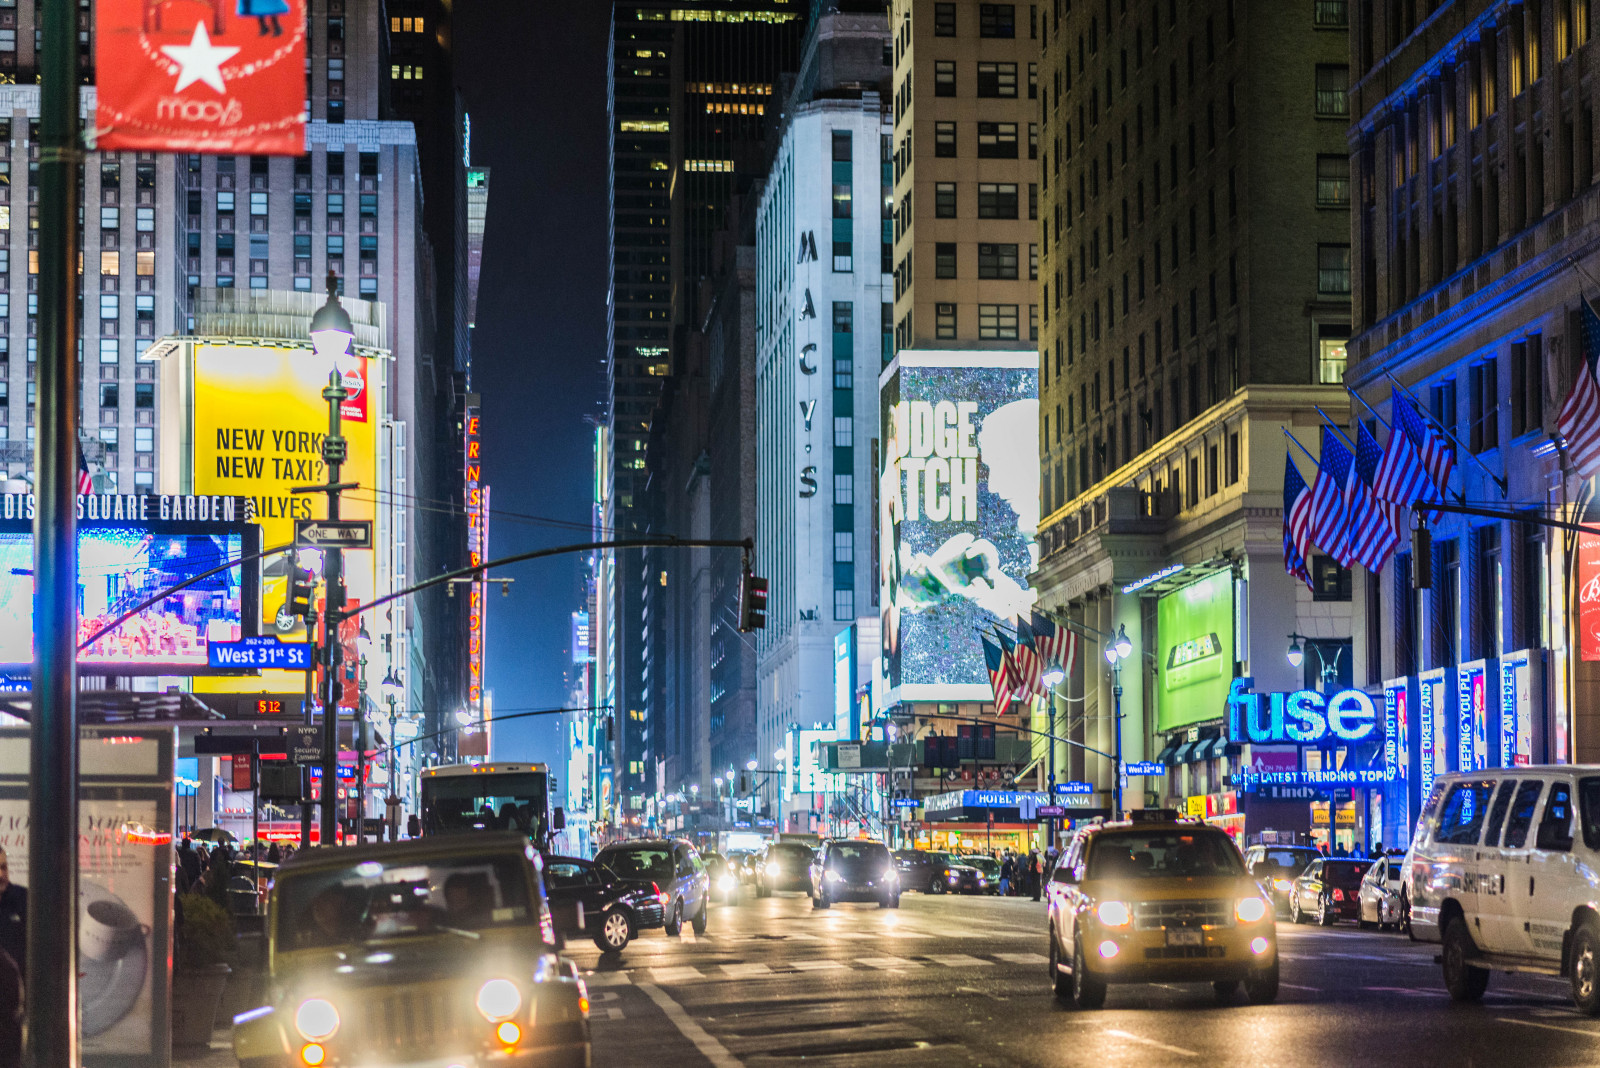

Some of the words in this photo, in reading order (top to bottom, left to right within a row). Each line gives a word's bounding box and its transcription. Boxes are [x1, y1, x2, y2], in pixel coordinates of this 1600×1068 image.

[217, 428, 264, 450] NEW
[217, 456, 264, 479] NEW
[272, 459, 324, 482] TAXI?
[467, 417, 480, 528] ERNST
[77, 494, 148, 520] SQUARE
[160, 496, 235, 522] GARDEN
[308, 529, 328, 539] ONE
[337, 529, 359, 539] WAY
[216, 647, 255, 663] West
[258, 647, 285, 663] 31st
[288, 647, 304, 664] St
[469, 591, 480, 702] YOUNG
[1227, 677, 1377, 744] fuse
[1461, 694, 1471, 721] YOU
[298, 727, 318, 735] NYPD
[294, 748, 320, 757] Security
[1128, 765, 1143, 774] West
[1156, 765, 1162, 773] St
[1261, 772, 1297, 783] LATEST
[1301, 771, 1357, 782] TRENDING
[979, 794, 1012, 804] HOTEL
